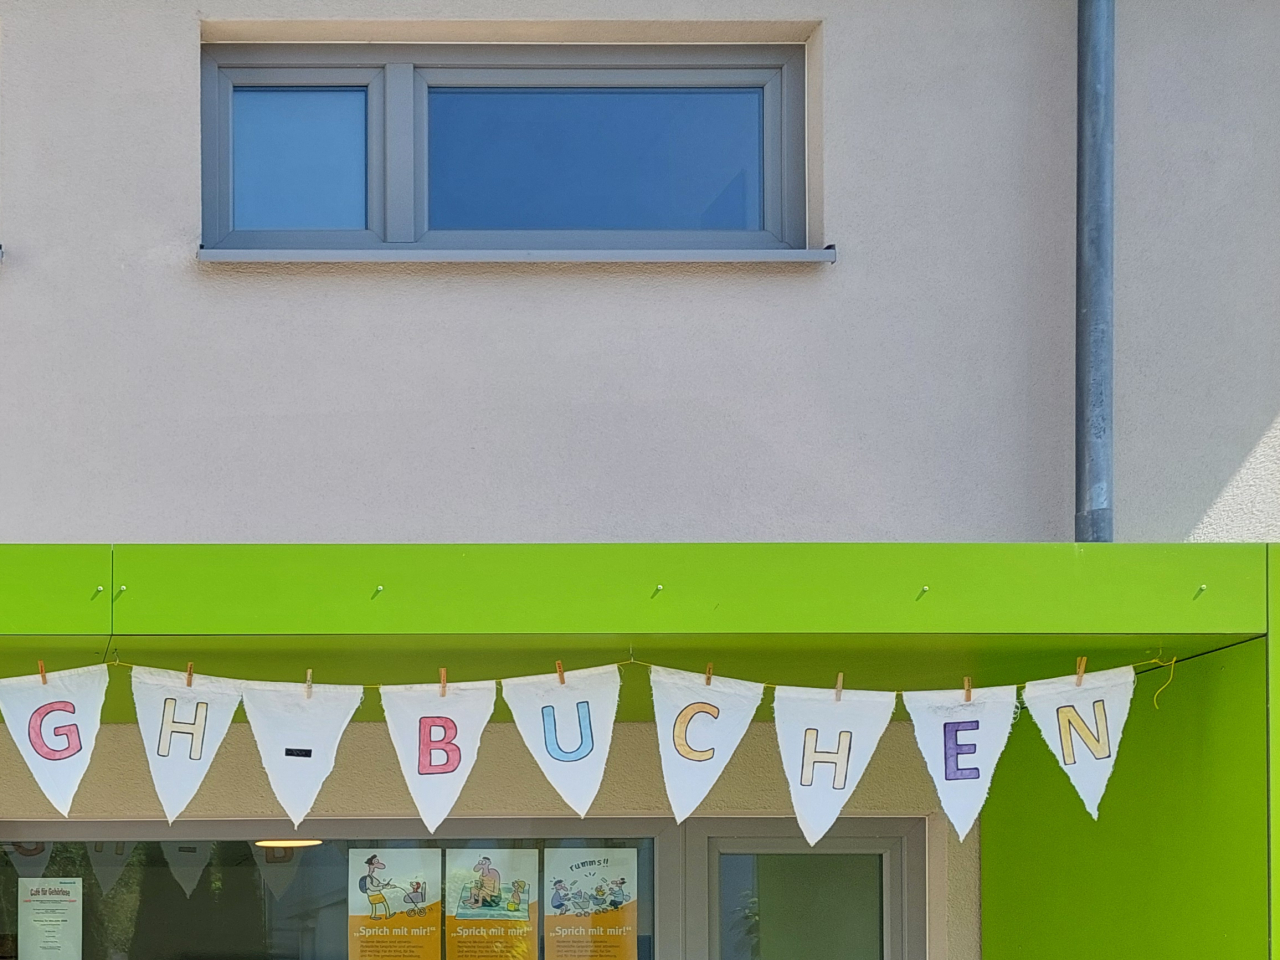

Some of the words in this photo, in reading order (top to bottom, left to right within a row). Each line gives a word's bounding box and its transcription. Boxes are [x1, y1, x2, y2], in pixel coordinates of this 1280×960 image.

[395, 926, 408, 936] mit
[489, 926, 505, 936] mit
[591, 926, 604, 936] mit
